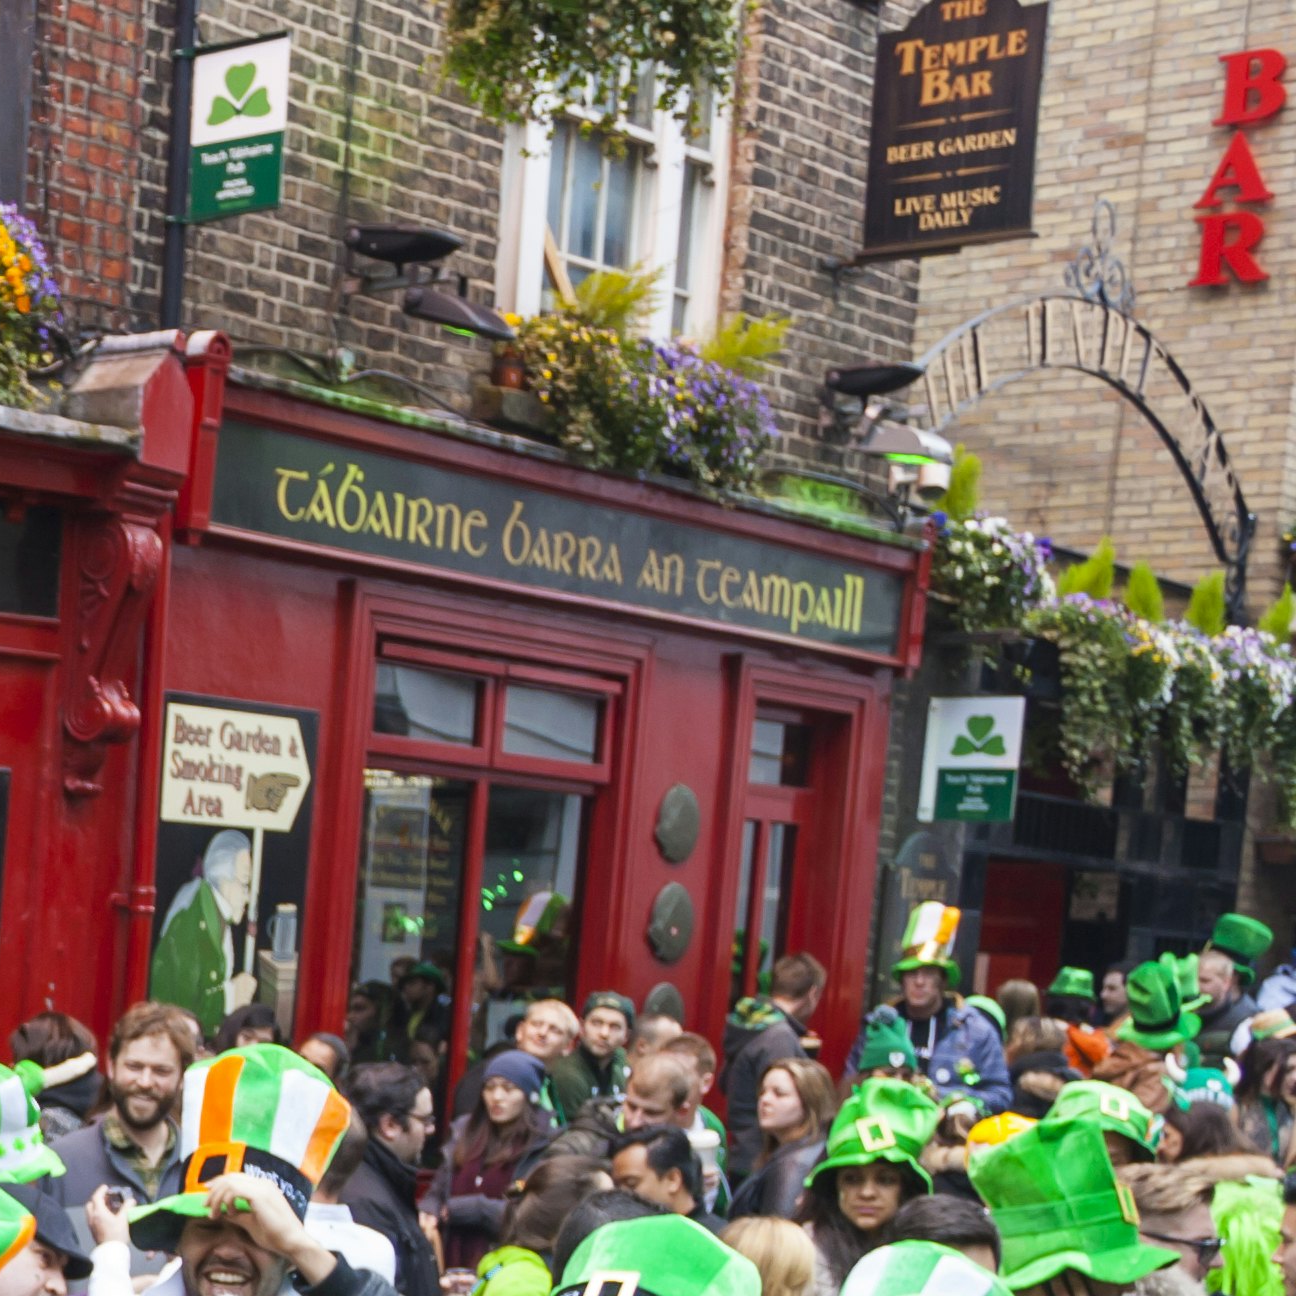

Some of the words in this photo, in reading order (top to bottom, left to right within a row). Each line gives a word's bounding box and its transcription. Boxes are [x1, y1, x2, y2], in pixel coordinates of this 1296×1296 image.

[895, 29, 1028, 77] TEMPLE
[920, 71, 992, 107] BAR
[886, 142, 935, 164] BEER
[938, 128, 1016, 157] GARDEN
[1188, 48, 1287, 287] BAR
[894, 194, 936, 216] LIVE
[940, 186, 1000, 210] MUSIC
[919, 207, 971, 231] DAILY
[173, 713, 212, 748] Beer
[220, 720, 281, 756] Garden
[171, 750, 243, 791] Smoking
[182, 787, 223, 818] Area
